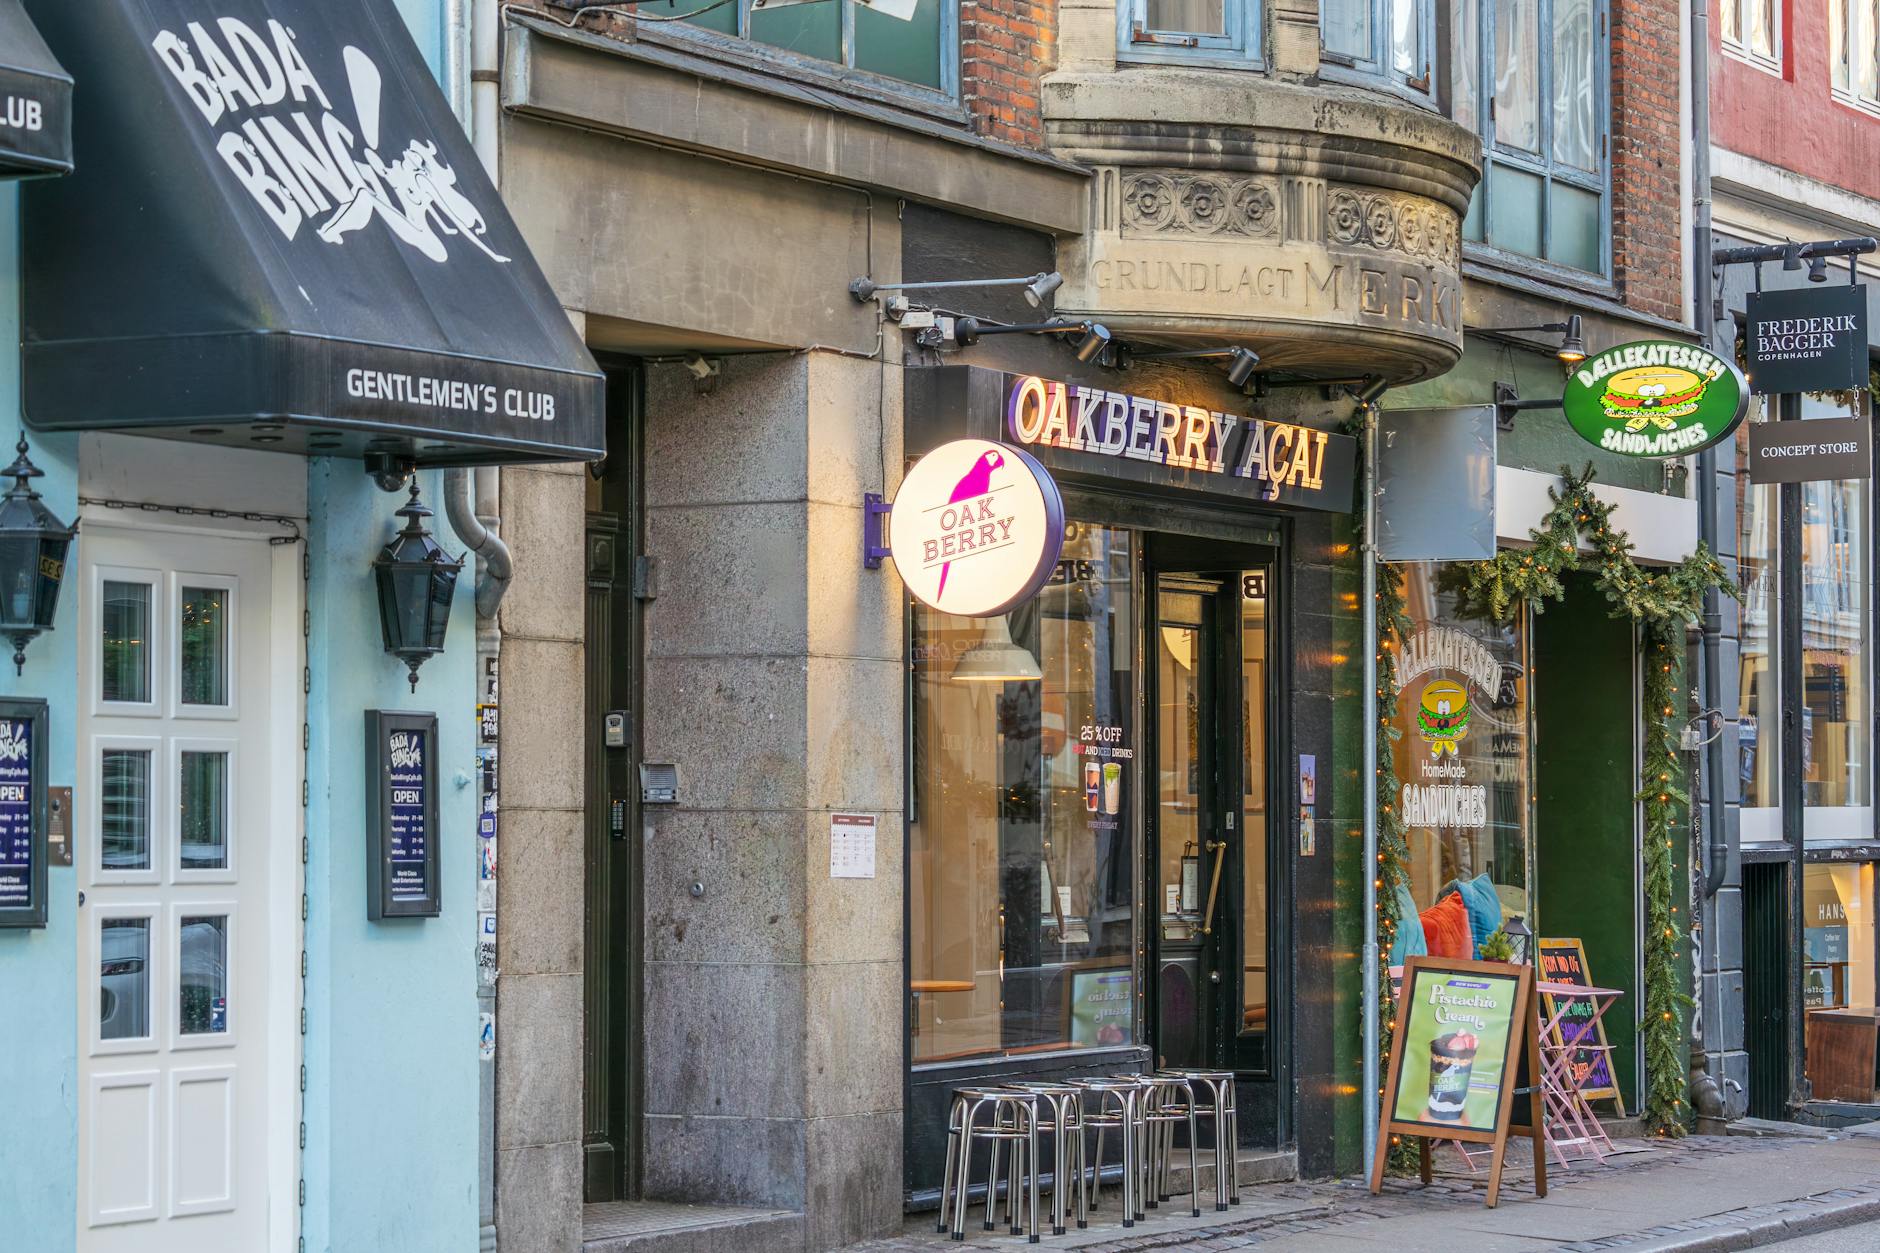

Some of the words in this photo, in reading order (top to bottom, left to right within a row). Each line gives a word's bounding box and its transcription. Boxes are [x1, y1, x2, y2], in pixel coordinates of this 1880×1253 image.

[152, 17, 332, 127] BADA
[1091, 260, 1294, 299] GRUNDLAGT
[1757, 314, 1857, 337] FREDERIK
[1758, 333, 1836, 353] BAGGER
[1758, 350, 1822, 361] COPENHAGEN
[1577, 345, 1726, 388] DÆLLEKATESSEN
[504, 389, 555, 421] CLUB
[1010, 376, 1237, 474] OAKBERRY
[1238, 420, 1328, 501] AÇAI
[1601, 422, 1708, 453] SANDWICHES
[1761, 445, 1816, 458] CONCEPT
[1819, 442, 1858, 454] STORE
[940, 497, 995, 531] OAK
[923, 516, 1015, 562] BERRY
[1081, 725, 1094, 740] 25
[1103, 727, 1122, 742] OFF
[1085, 745, 1098, 756] AND
[1111, 747, 1133, 758] DRINKS
[1421, 760, 1466, 778] HomeMade
[394, 790, 419, 803] OPEN
[1402, 783, 1487, 828] SANDWICHES
[1429, 984, 1497, 1009] Pistachio
[1434, 1006, 1485, 1031] Cream
